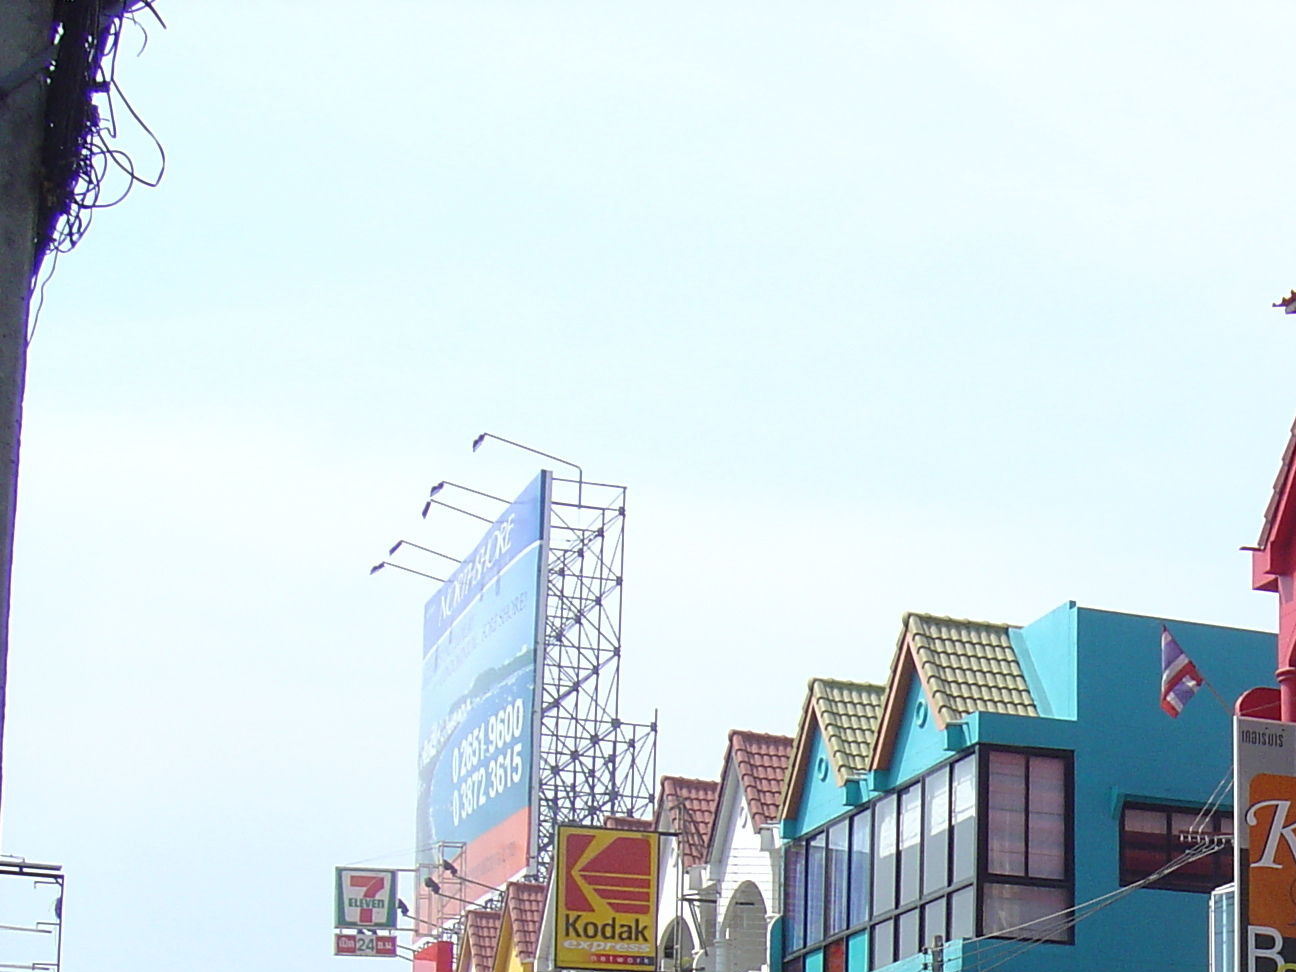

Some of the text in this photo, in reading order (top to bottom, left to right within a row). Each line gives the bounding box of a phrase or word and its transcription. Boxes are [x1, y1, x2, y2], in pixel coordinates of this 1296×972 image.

[452, 698, 524, 783] 0 2651 9600
[452, 742, 523, 826] 0 3872 3615
[349, 875, 385, 923] 7
[564, 913, 649, 942] Kodak
[357, 938, 375, 952] 24
[562, 939, 652, 953] express
[590, 954, 651, 965] network
